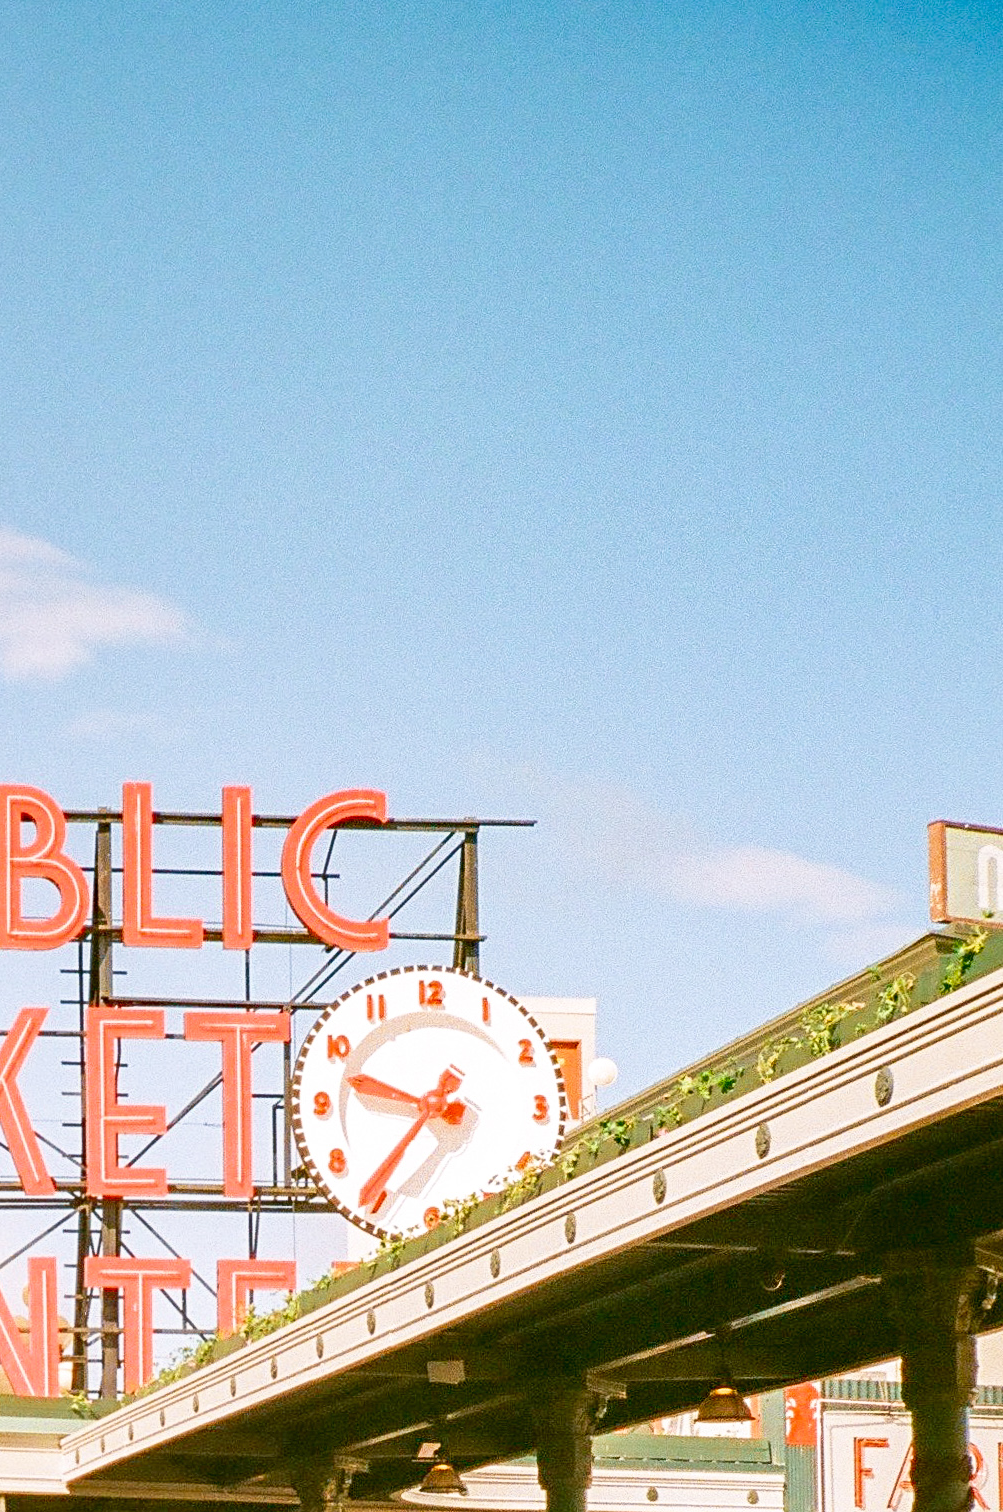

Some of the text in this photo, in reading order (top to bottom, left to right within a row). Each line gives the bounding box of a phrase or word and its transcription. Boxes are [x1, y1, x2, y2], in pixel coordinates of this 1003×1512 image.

[419, 980, 443, 1005] 12
[367, 994, 385, 1021] 11
[482, 997, 490, 1022] 1
[327, 1034, 350, 1060] 10
[518, 1039, 534, 1063] 2
[314, 1091, 330, 1115] 9
[532, 1095, 548, 1121] 3
[328, 1148, 346, 1174] 8
